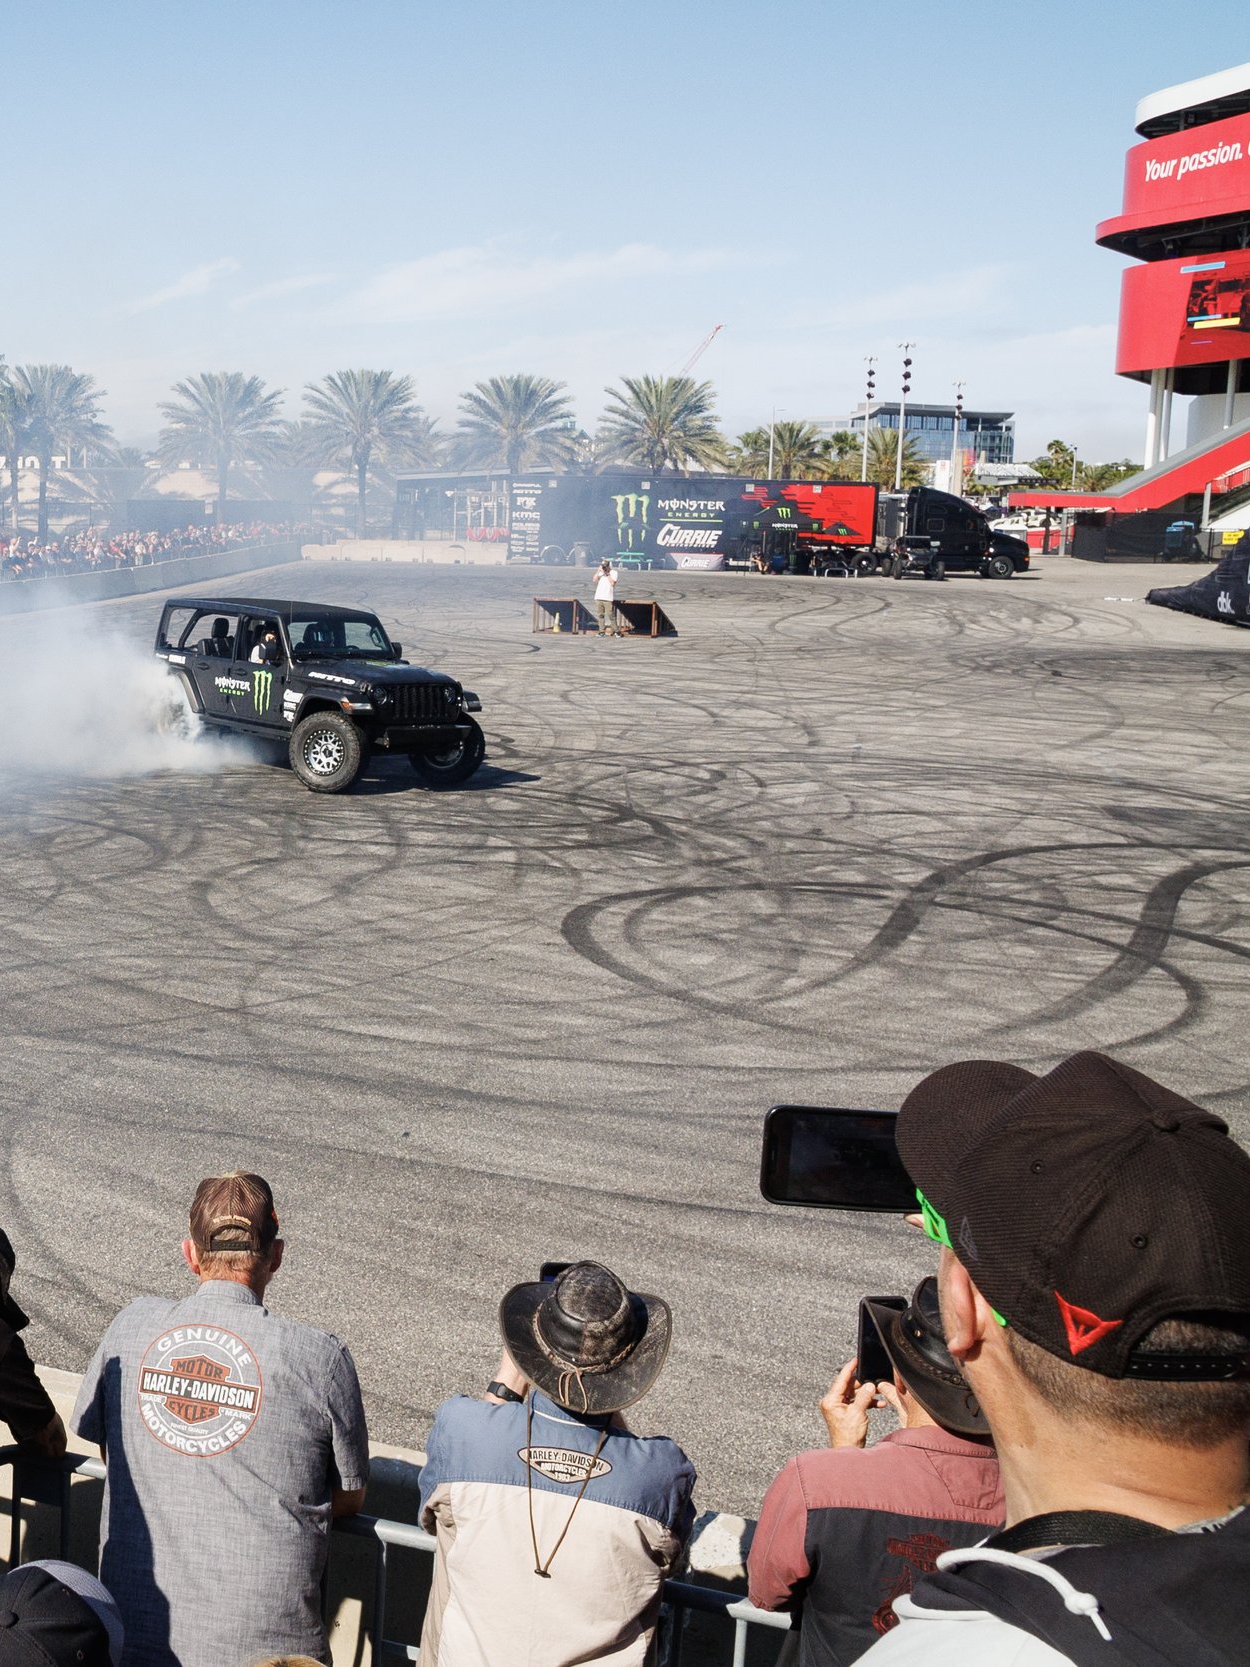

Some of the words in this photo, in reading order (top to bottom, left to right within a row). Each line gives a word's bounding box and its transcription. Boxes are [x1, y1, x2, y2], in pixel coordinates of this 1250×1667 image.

[1146, 159, 1177, 182] Your
[1177, 141, 1243, 180] passion.
[657, 498, 726, 511] MONSTER
[656, 523, 723, 546] CURRIE
[215, 676, 250, 692] MONSTER
[157, 1328, 252, 1367] GENUINE
[176, 1359, 223, 1379] MOTOR
[143, 1372, 255, 1409] HARLEY-DAVIDSON
[169, 1400, 216, 1421] CYCLES
[141, 1402, 247, 1453] MOTORCYCLES
[540, 1462, 587, 1477] MOTORCYCLES
